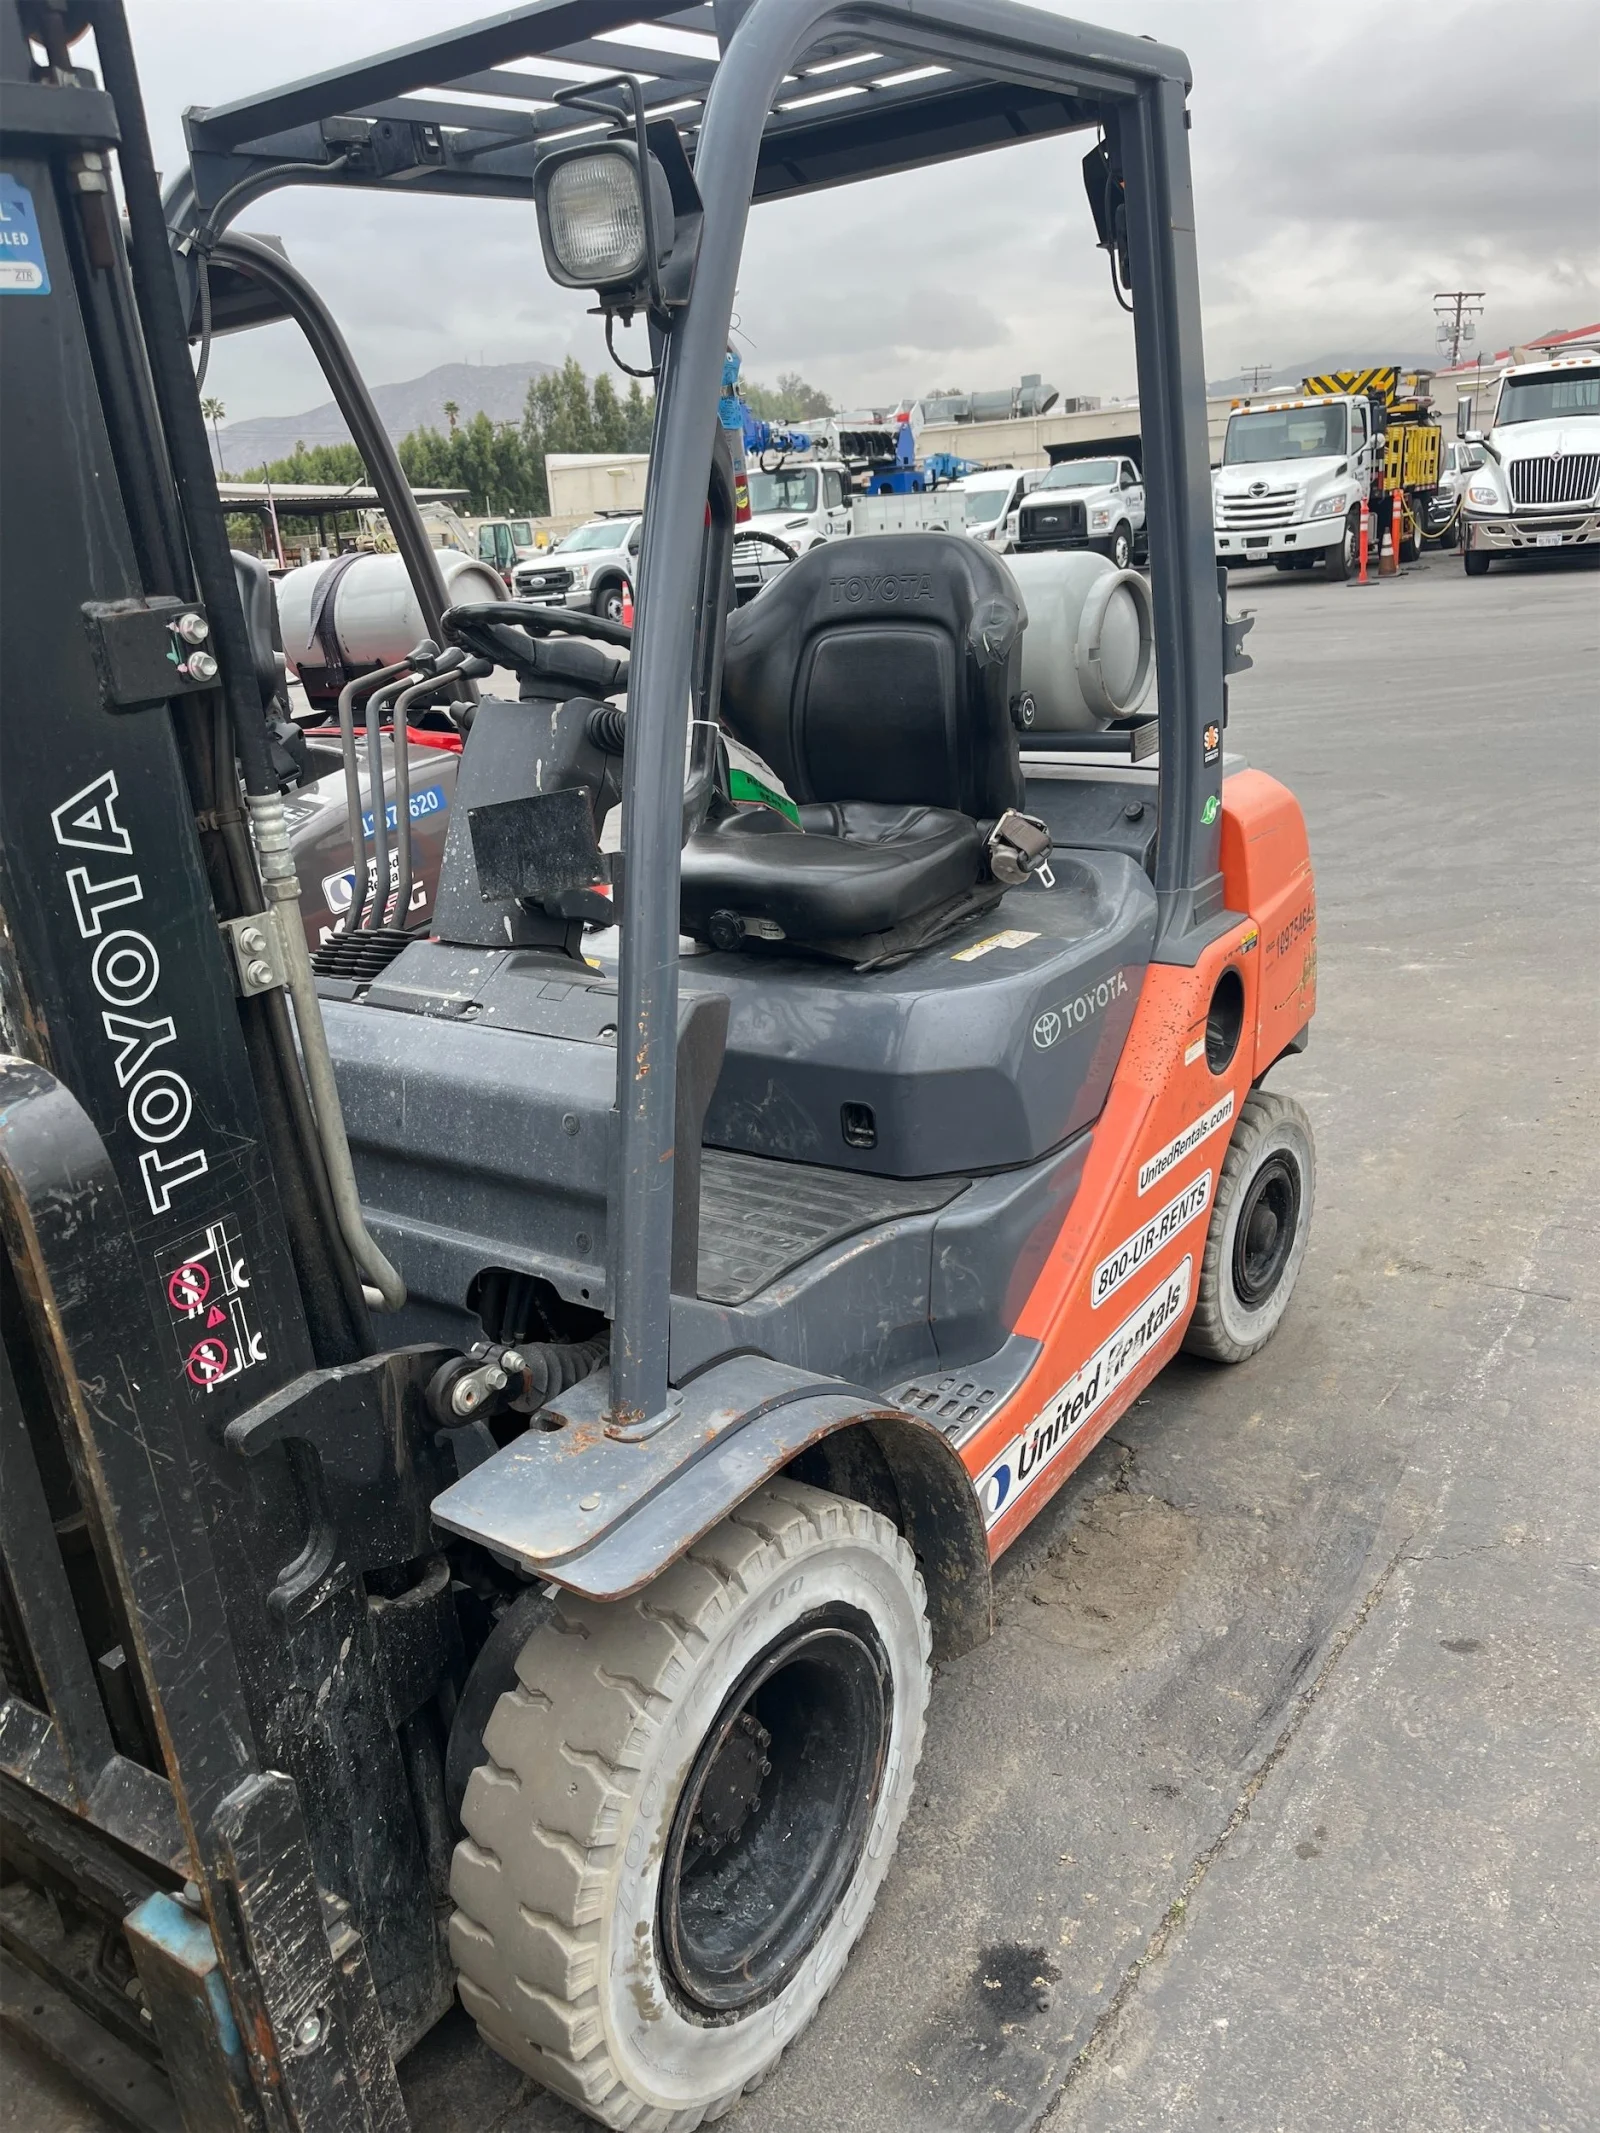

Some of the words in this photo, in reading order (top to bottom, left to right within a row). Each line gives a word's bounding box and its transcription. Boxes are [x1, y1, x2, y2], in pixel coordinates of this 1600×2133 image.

[829, 573, 935, 604] TOYOTA
[50, 769, 210, 1215] TOYOTA
[1061, 971, 1129, 1029] TOYOTA
[1140, 1100, 1233, 1190] UnitedRentals.com
[1098, 1180, 1206, 1296] 800-UR-RENTS
[1018, 1361, 1102, 1481] United
